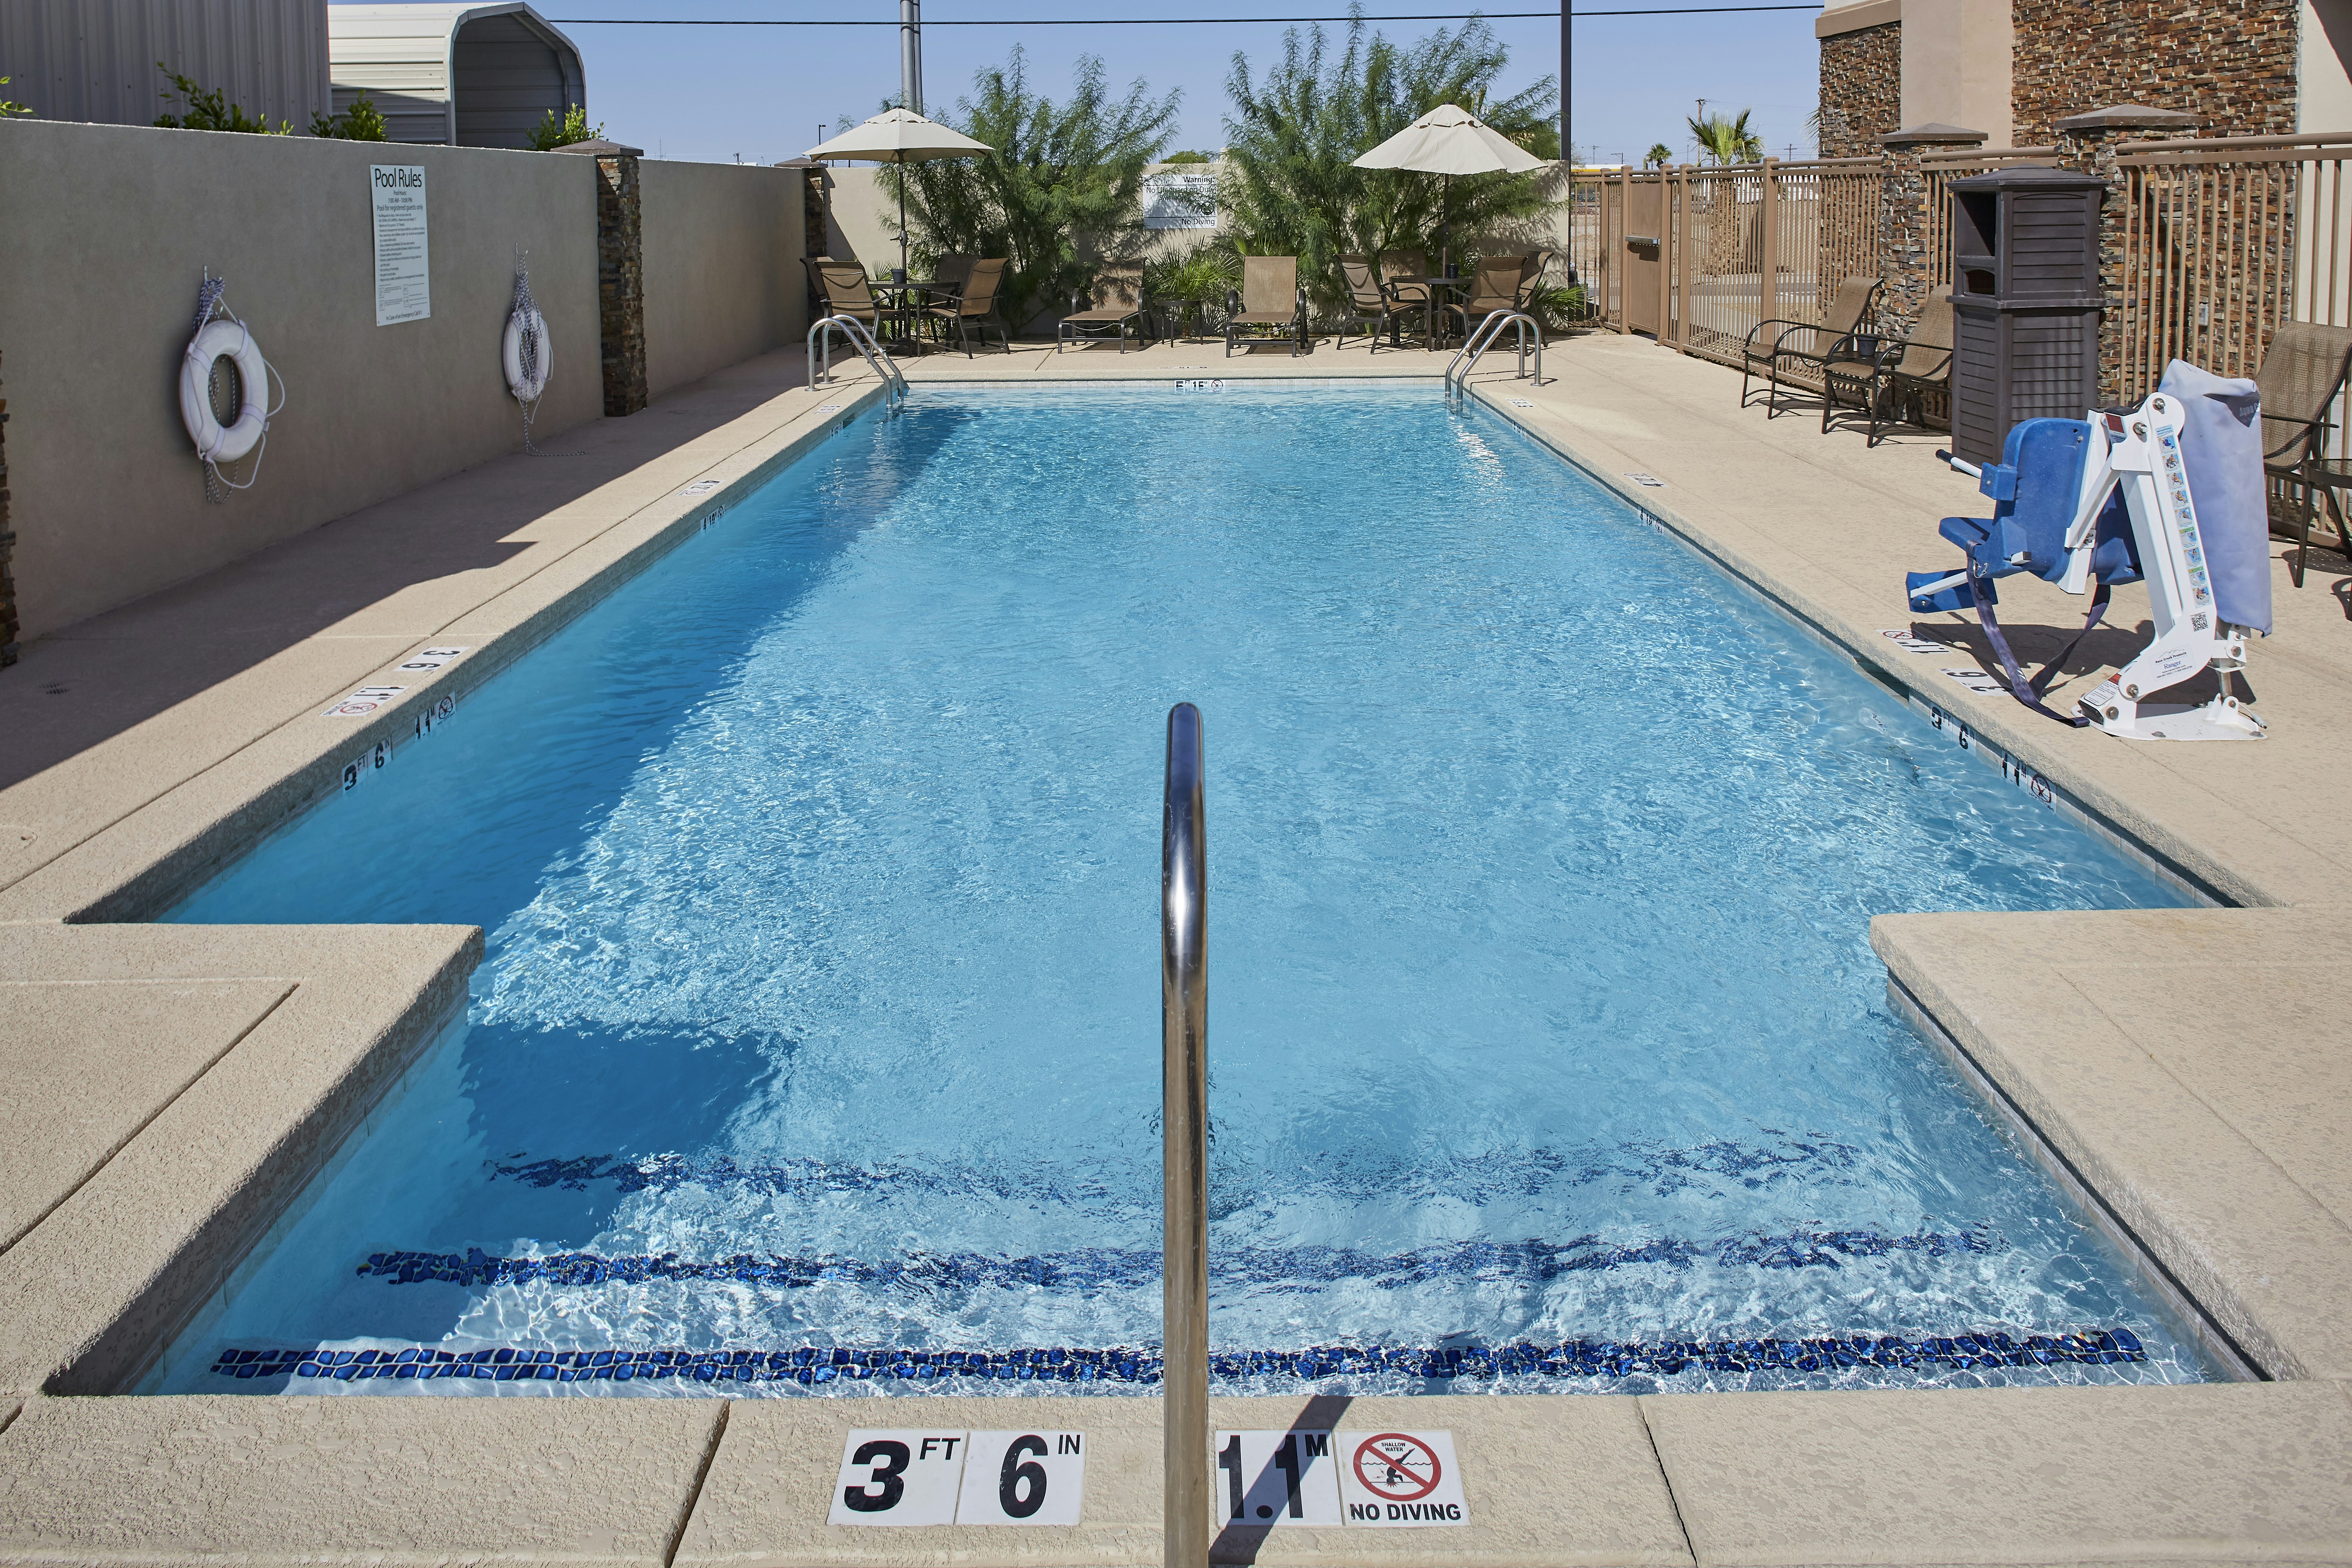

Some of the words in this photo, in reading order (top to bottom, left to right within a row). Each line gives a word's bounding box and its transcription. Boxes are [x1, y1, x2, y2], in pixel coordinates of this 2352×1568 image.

[375, 168, 396, 187] Pool
[399, 168, 422, 187] Rules
[1194, 218, 1215, 226] Diving
[2163, 661, 2181, 669] Ranger
[1931, 706, 1942, 730] 3
[1943, 712, 1951, 726] FT
[1959, 724, 1968, 749] 6
[344, 765, 356, 791] 3
[358, 755, 366, 771] FT
[375, 742, 385, 769] 6
[844, 1440, 910, 1512] 3
[919, 1437, 961, 1460] FT
[999, 1434, 1048, 1518] 6
[1058, 1434, 1080, 1454] IN
[1219, 1434, 1303, 1518] 1.1
[1305, 1434, 1328, 1456] M
[1350, 1503, 1380, 1520] NO
[1387, 1503, 1461, 1520] DIVING
